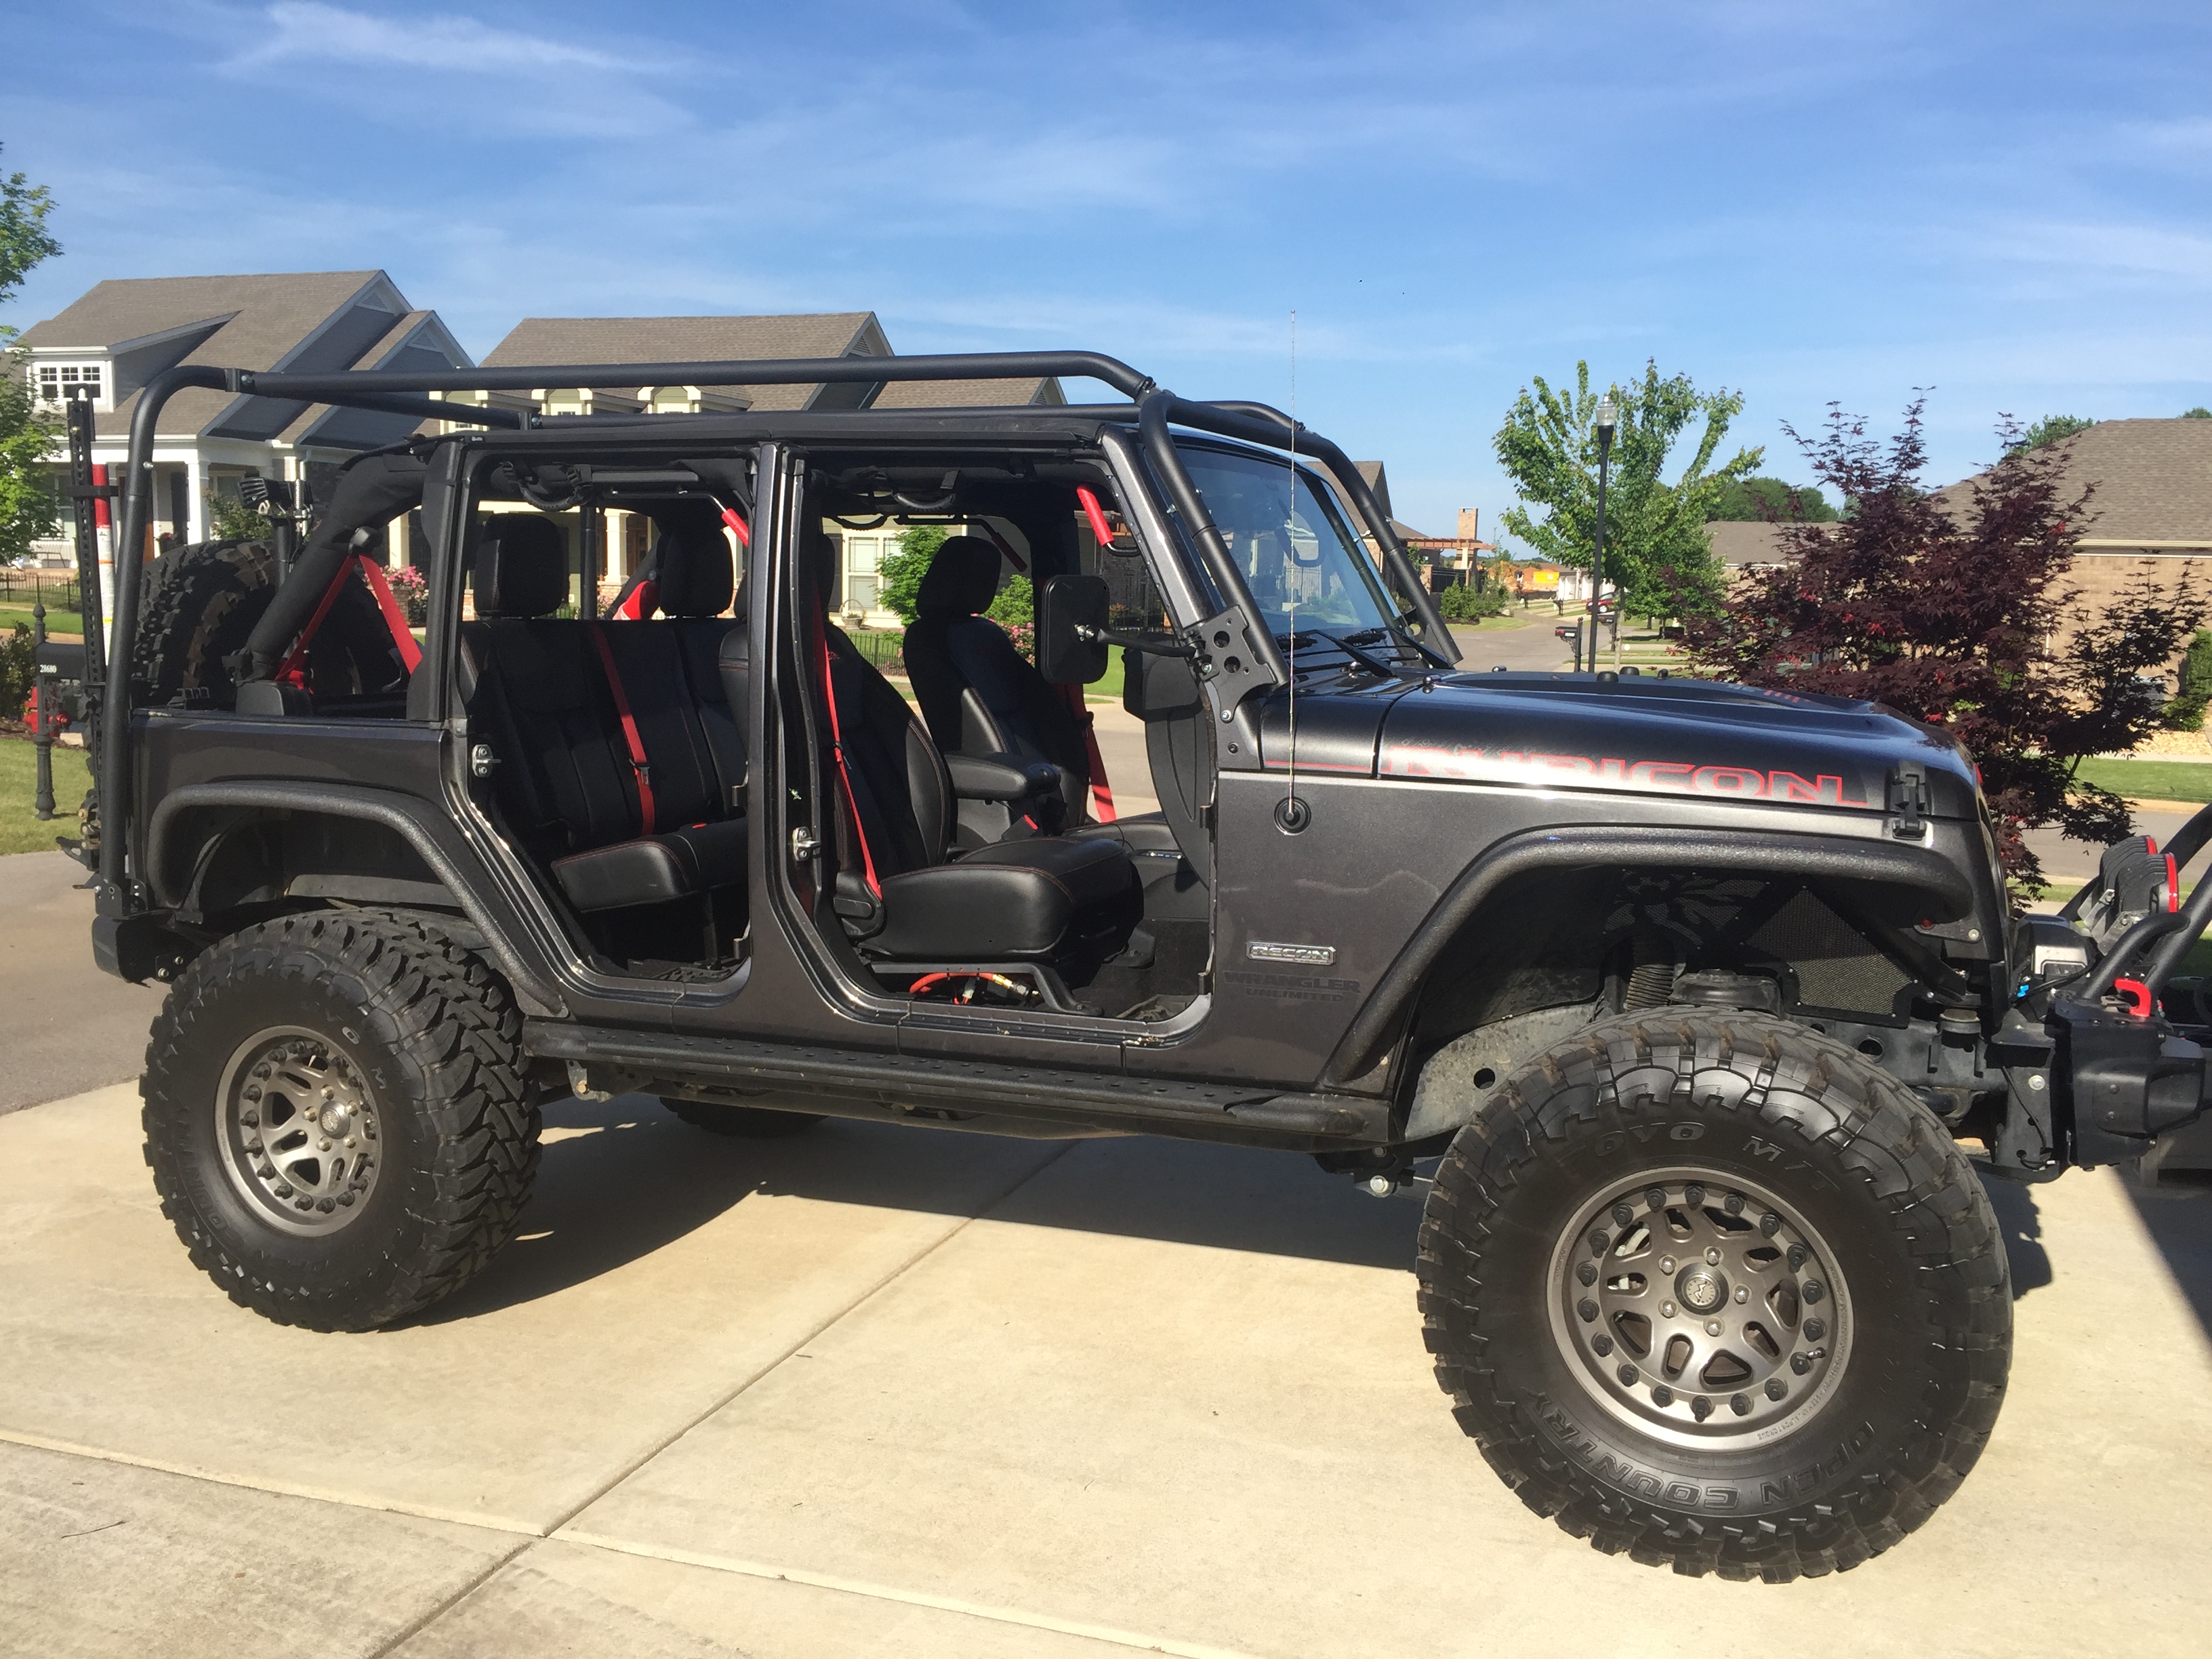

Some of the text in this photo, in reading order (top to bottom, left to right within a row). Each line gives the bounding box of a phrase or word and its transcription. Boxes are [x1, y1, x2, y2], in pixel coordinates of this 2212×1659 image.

[1250, 945, 1330, 960] RECON
[1223, 970, 1361, 993] WRANGLER
[1246, 987, 1345, 1002] UNLIMITED
[1521, 1387, 1740, 1510] COUNTRY
